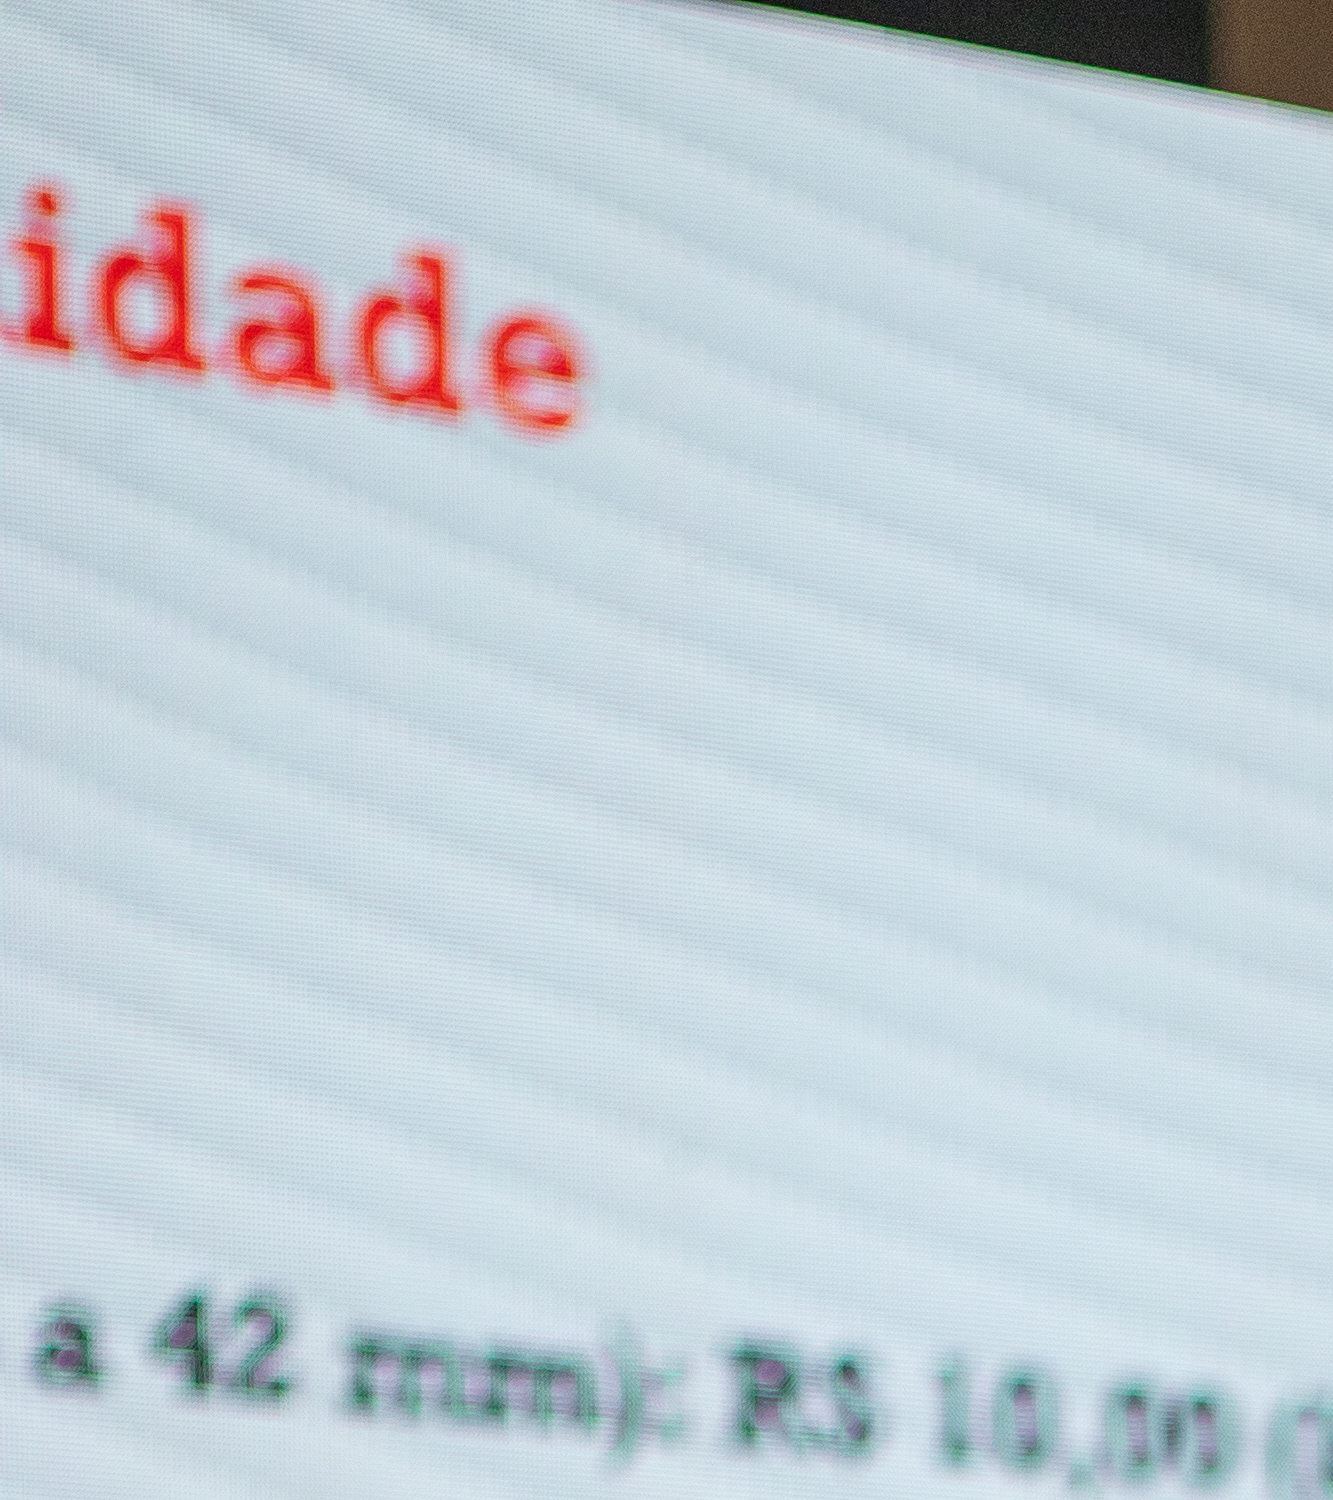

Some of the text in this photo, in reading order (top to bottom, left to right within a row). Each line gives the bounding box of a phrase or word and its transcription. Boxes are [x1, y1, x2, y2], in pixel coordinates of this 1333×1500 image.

[31, 1301, 105, 1394] a
[150, 1290, 296, 1404] 42
[337, 1320, 690, 1462] mm):
